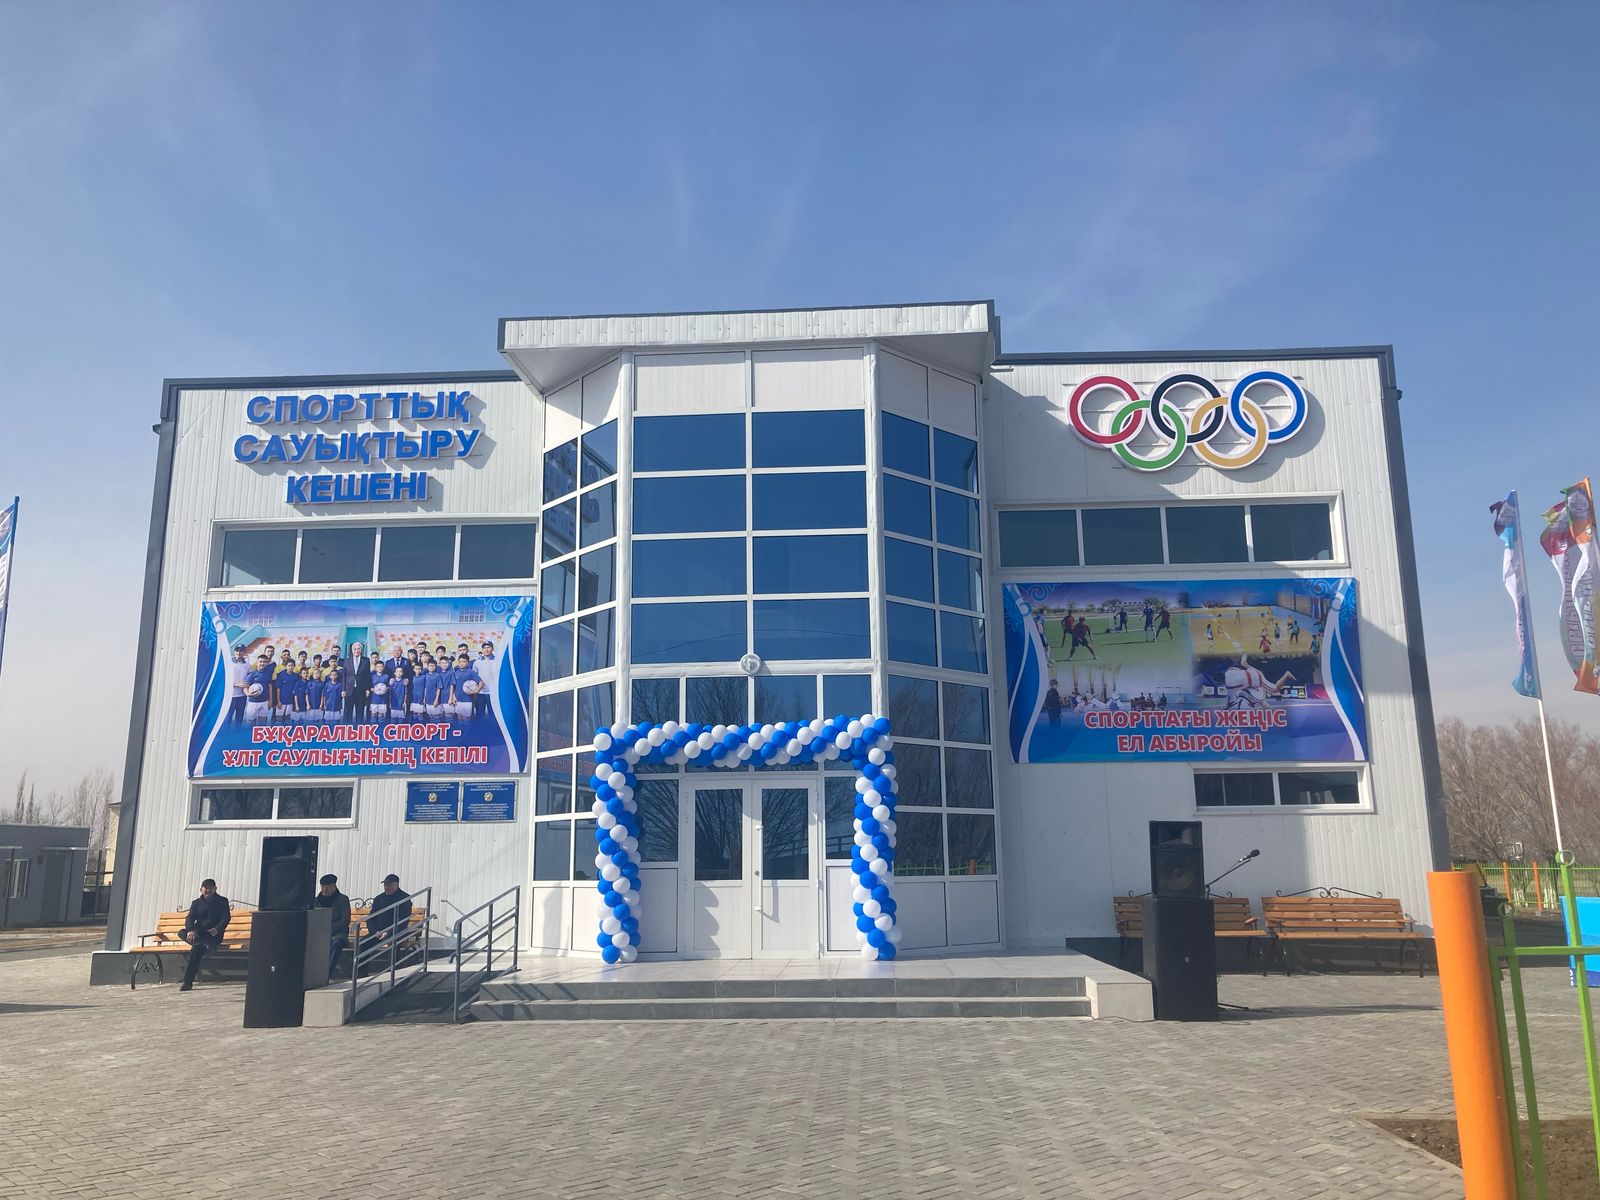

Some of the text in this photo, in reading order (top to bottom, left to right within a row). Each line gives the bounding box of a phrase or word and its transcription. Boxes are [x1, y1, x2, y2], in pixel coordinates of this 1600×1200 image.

[247, 391, 471, 424] СПОРТТЫҚ
[234, 429, 480, 465] САУЫҚТЫРУ
[286, 472, 428, 503] КЕШЕНІ
[1084, 709, 1288, 731] СПОРТТАҒЫ ЖЕҢІС
[252, 726, 379, 746] БҰҚАРАЛЫҚ
[384, 723, 451, 741] СПОРТ
[1117, 729, 1263, 752] ЕЛ АБЫРОЙЫ
[223, 746, 488, 769] ҰЛТ САУЛЫҒЫНЫҢ КЕПІЛІ
